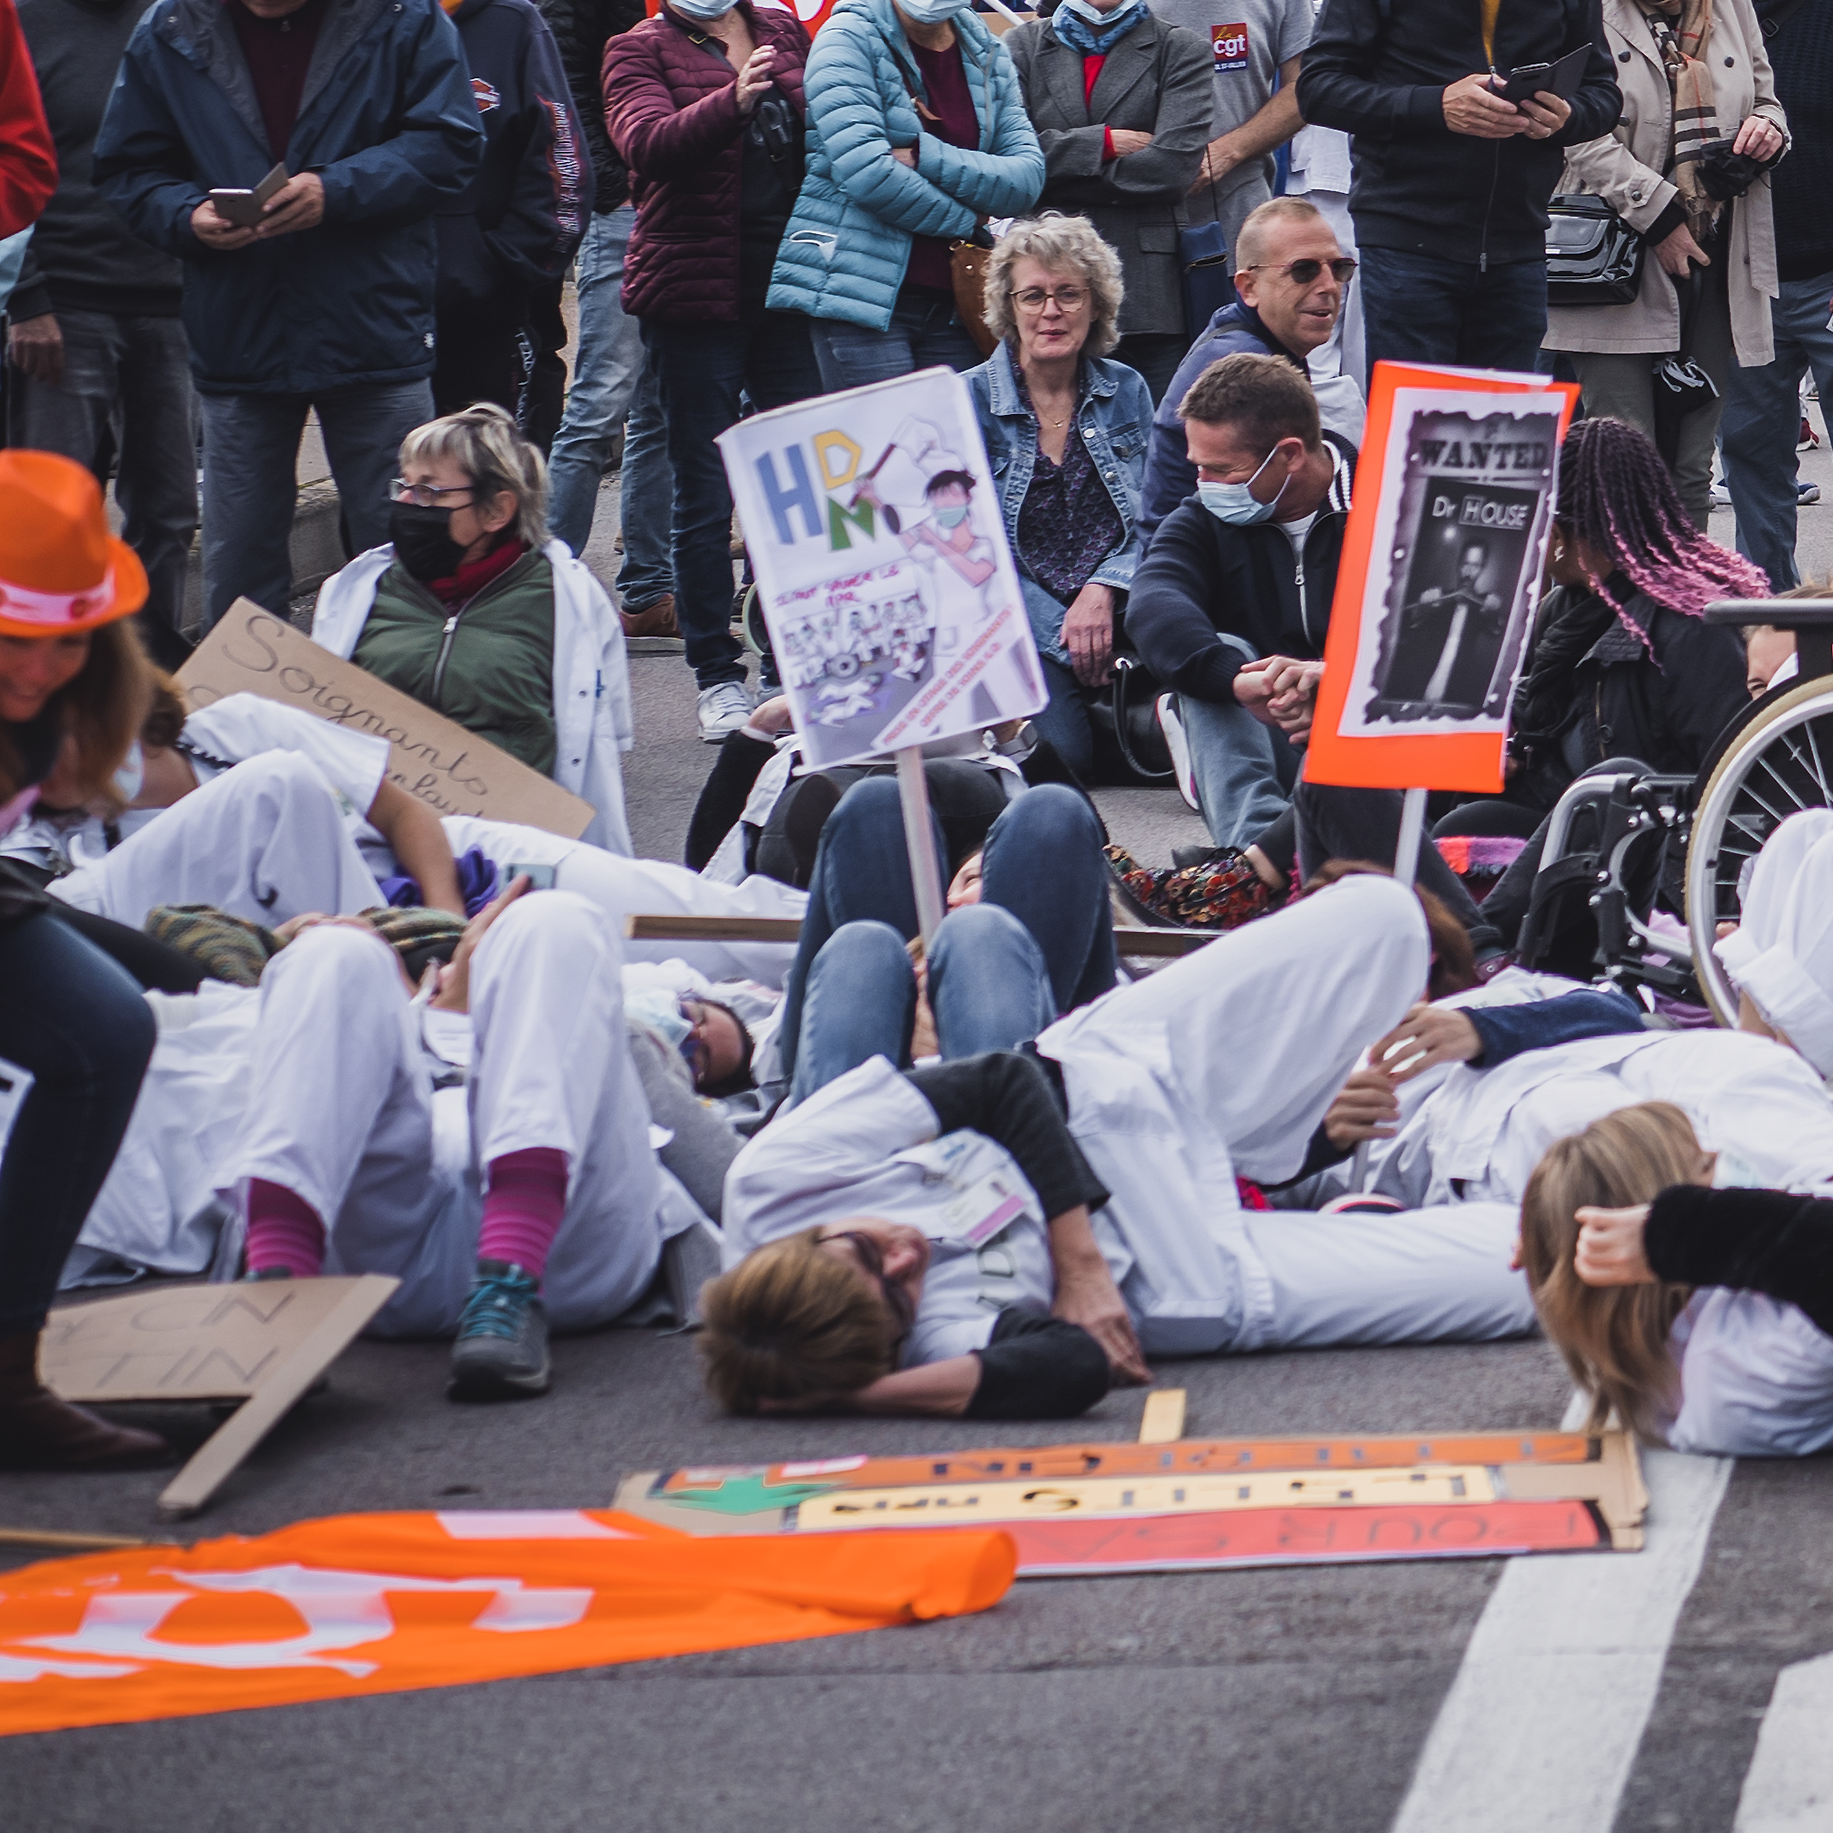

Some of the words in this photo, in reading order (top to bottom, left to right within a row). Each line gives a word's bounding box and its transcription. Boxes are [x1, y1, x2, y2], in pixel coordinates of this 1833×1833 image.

[1213, 34, 1246, 57] cgt
[1420, 439, 1550, 469] WANTED
[1432, 495, 1458, 518] Dr
[1463, 495, 1529, 527] HOUSE
[221, 614, 490, 797] Soignants
